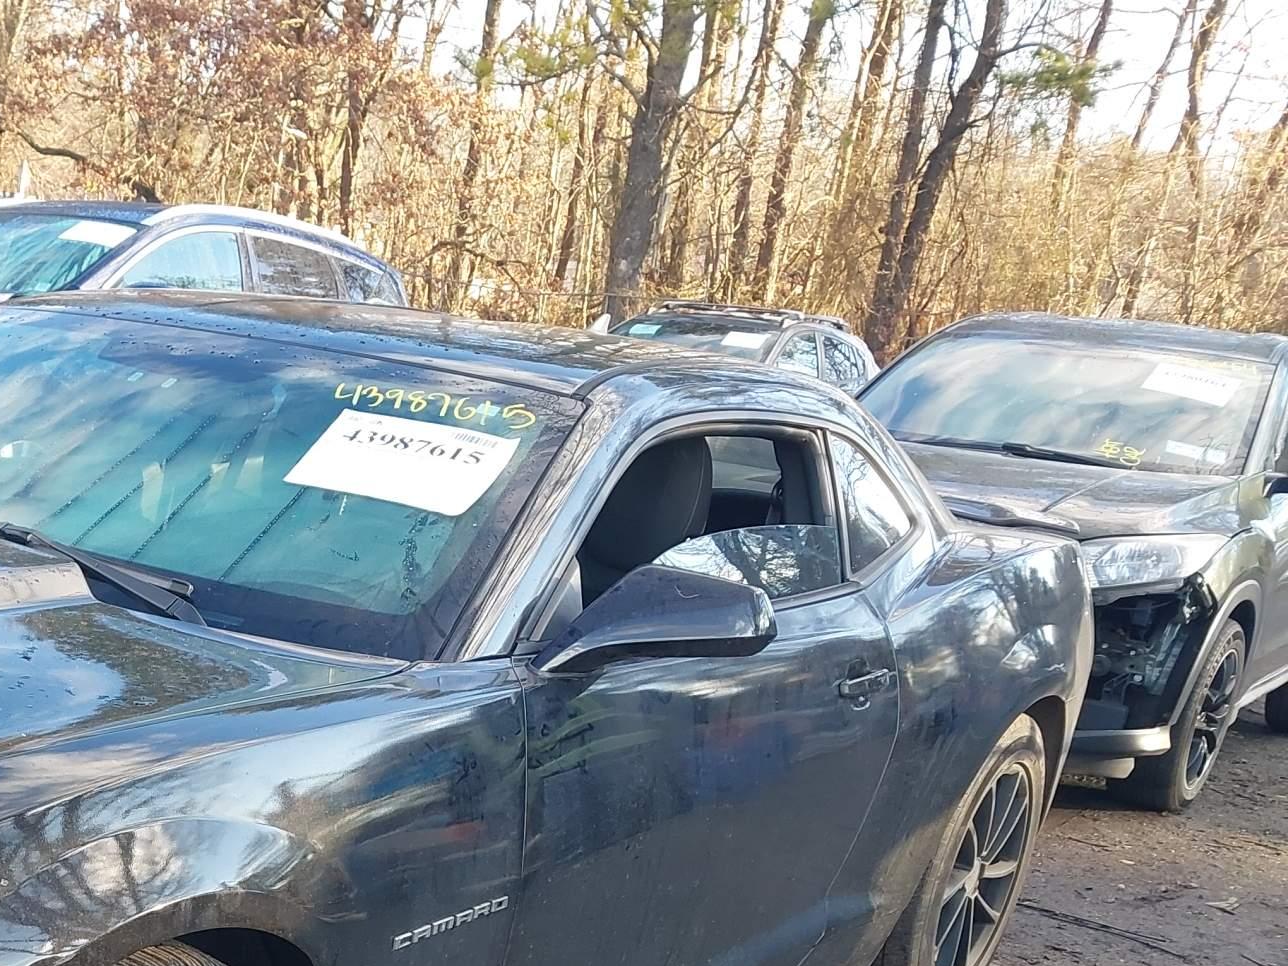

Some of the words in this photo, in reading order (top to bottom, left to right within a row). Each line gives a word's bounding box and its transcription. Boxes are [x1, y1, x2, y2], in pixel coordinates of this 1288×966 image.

[334, 382, 537, 430] 43987615
[342, 428, 486, 465] 43987615
[392, 895, 509, 951] CAMARO
